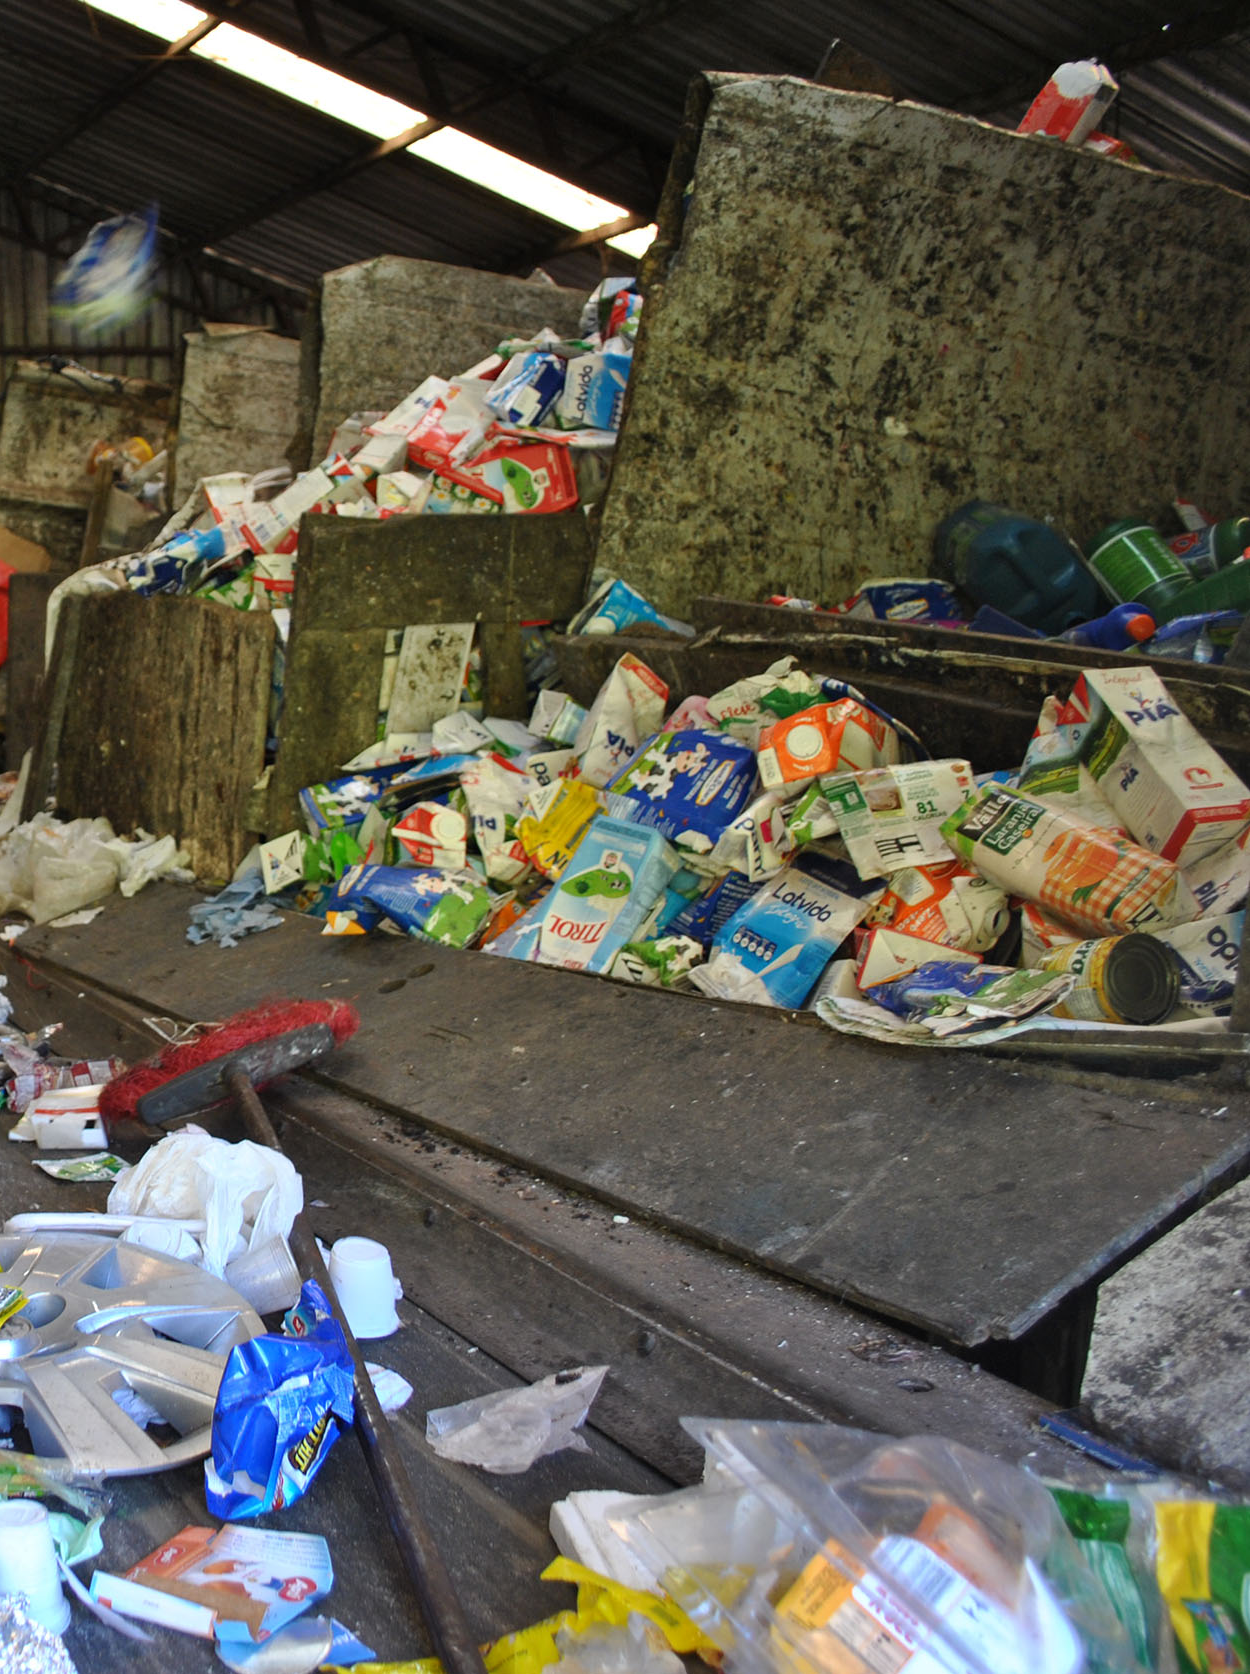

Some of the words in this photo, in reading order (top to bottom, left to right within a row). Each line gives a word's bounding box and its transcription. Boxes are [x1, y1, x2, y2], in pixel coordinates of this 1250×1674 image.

[1125, 697, 1180, 726] PIÁ
[916, 800, 938, 814] 81
[986, 804, 1029, 845] Laranja
[997, 807, 1040, 850] Caseira
[549, 914, 607, 944] TIROL
